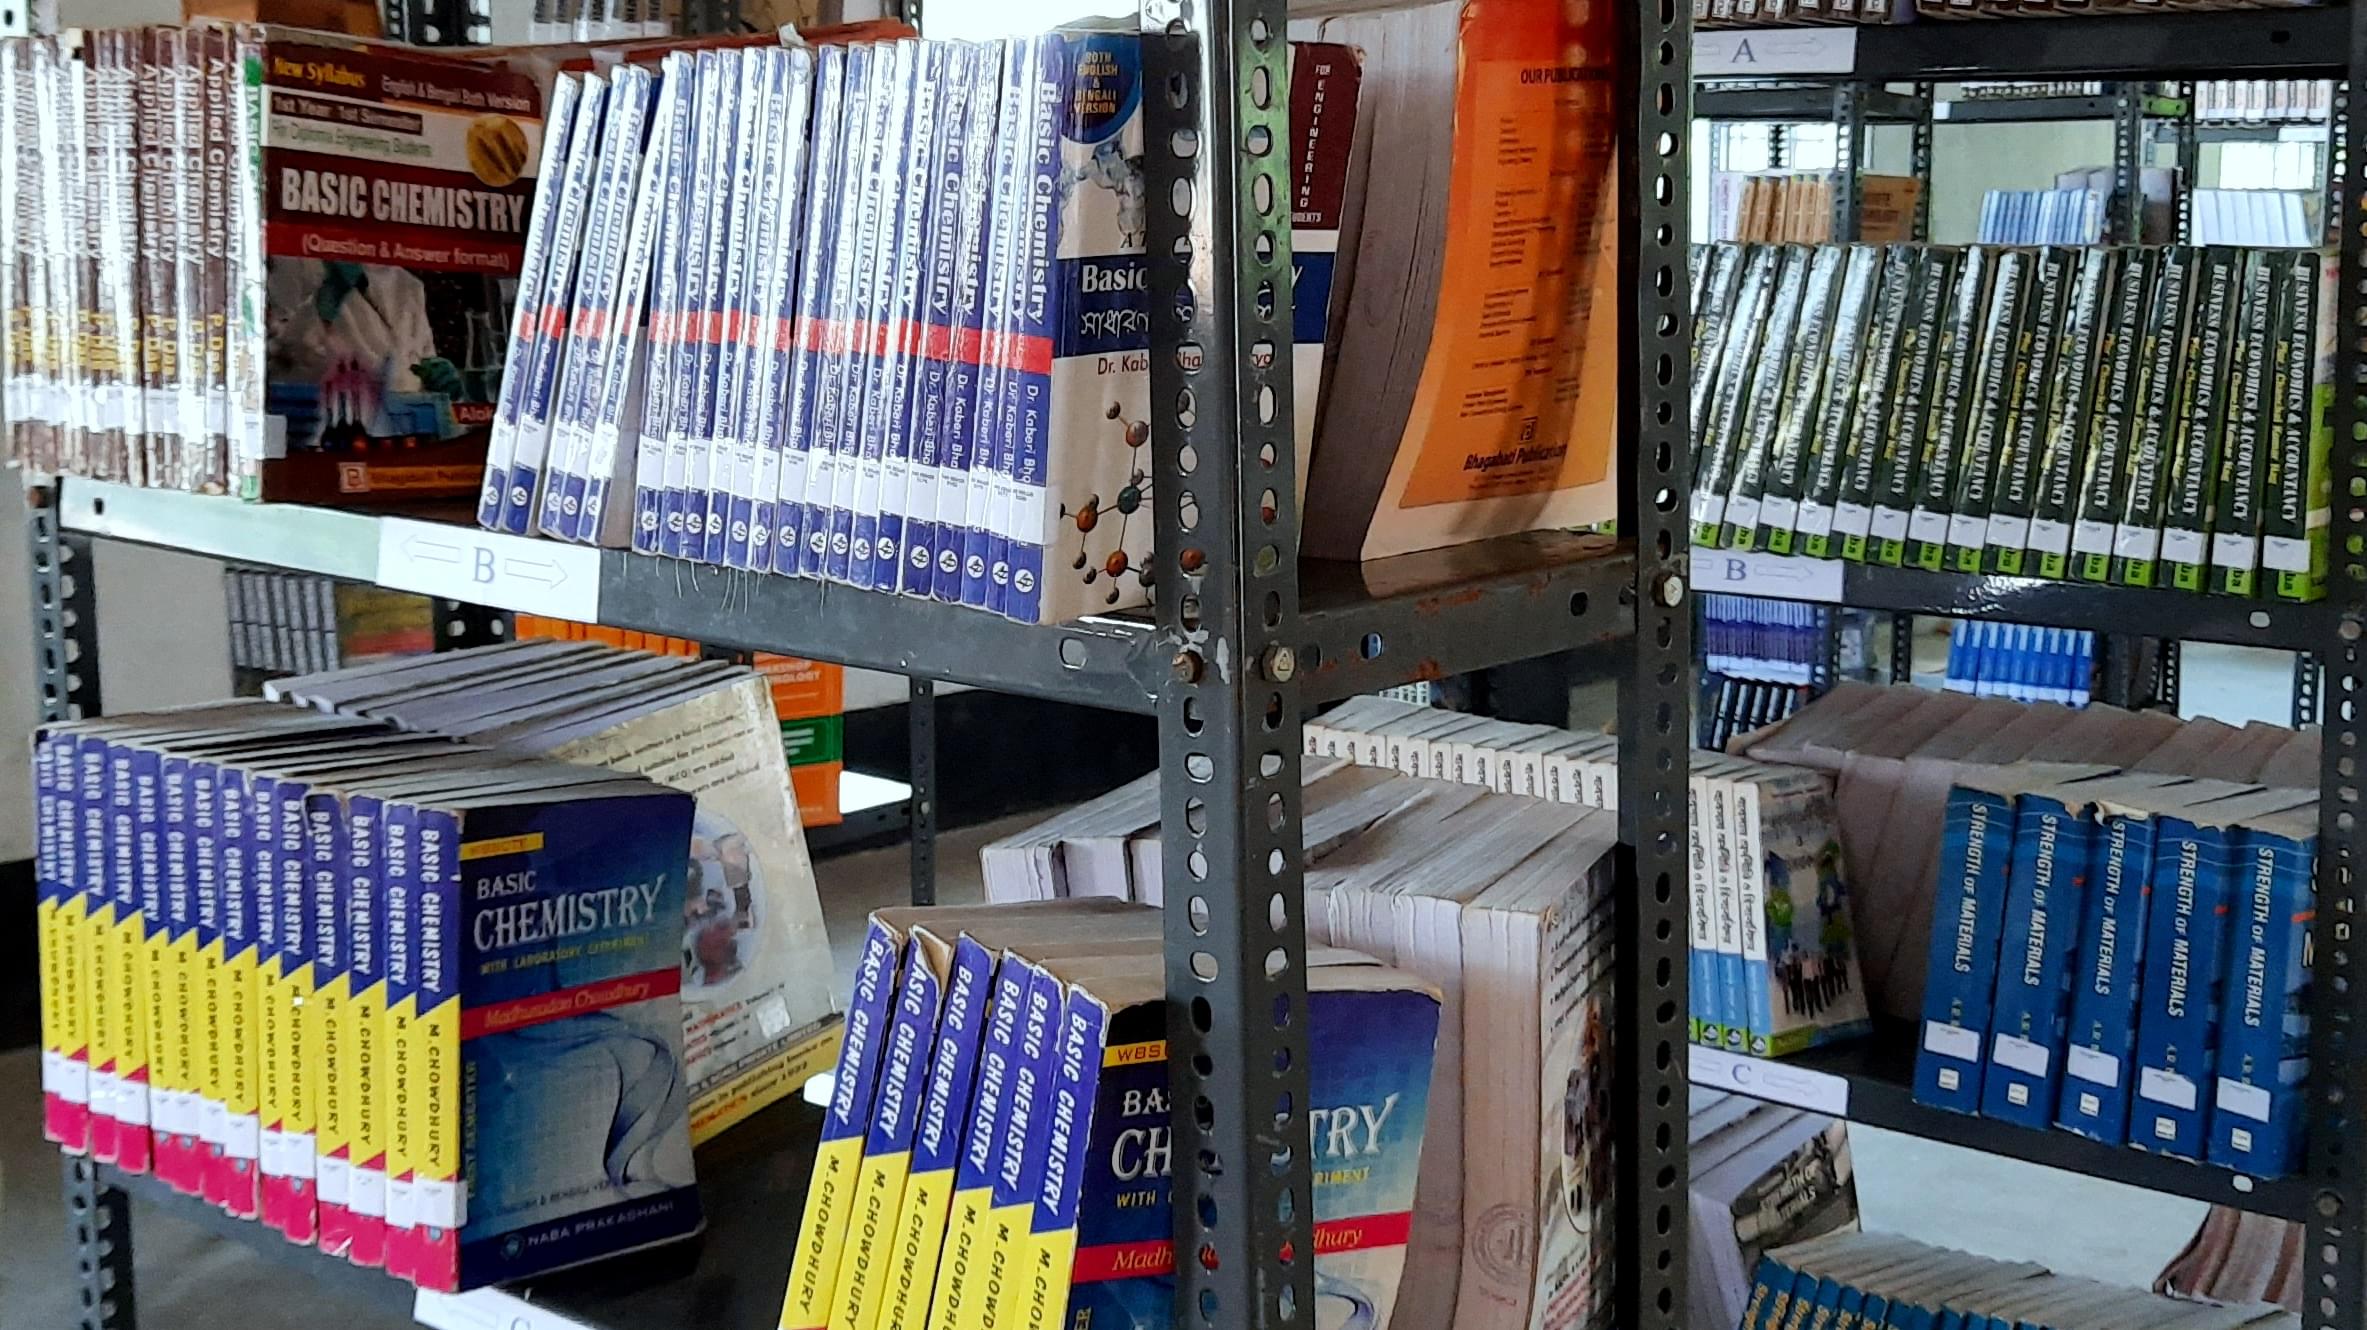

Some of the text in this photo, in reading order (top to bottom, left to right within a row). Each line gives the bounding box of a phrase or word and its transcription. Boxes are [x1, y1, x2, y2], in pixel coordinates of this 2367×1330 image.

[274, 57, 367, 88] New Syllabus
[1077, 64, 1118, 76] ENGLISH
[1315, 64, 1331, 75] FOR
[1520, 68, 1543, 84] OUR
[1731, 38, 1756, 63] A
[1074, 101, 1116, 113] VERSION
[281, 167, 526, 234] BASIC CHEMISTRY
[1026, 82, 1056, 325] Basic Chemistry
[931, 172, 960, 316] Chemistry
[1097, 353, 1149, 375] Dr. Kab
[473, 548, 496, 584] B
[1725, 558, 1747, 581] B
[195, 779, 217, 928] BASIC CHEMISTRY
[223, 789, 244, 940] BASIC CHEMISTRY
[255, 791, 274, 944] BASIC CHEMISTRY
[282, 799, 302, 956] BASIC CHEMISTRY
[1967, 803, 1988, 876] STRENGTH
[2035, 813, 2058, 887] STRENGTH
[2105, 820, 2125, 895] STRENGTH
[2177, 840, 2198, 916] STRENGTH
[310, 811, 335, 967] BASIC CHEMISTRY
[352, 815, 372, 975] BASIC CHEMISTRY
[388, 824, 407, 986] BASIC CHEMISTRY
[420, 829, 441, 993] BASIC CHEMISTRY
[474, 872, 667, 951] CHEMISTRY
[477, 870, 537, 900] BASIC
[2253, 847, 2274, 924] STRENGTH
[1954, 895, 1977, 972] MATERIALS
[2024, 907, 2047, 986] MATERIALS
[2095, 916, 2116, 995] MATERIALS
[2168, 938, 2189, 1018] MATERIALS
[2245, 945, 2266, 1027] MATERIALS
[834, 939, 884, 1126] BASIC CHEMISTRY
[878, 958, 928, 1140] ASIC CHEMISTRY
[921, 965, 974, 1158] BASIC CHEMISTRY
[1117, 1042, 1168, 1062] WBS
[969, 979, 1021, 1176] BASIC CHEMISTRY
[1000, 991, 1048, 1191] BASIC CHEMISTRY
[1041, 1011, 1087, 1217] BASIC CHEMISTRY
[1732, 1064, 1752, 1085] C
[528, 1224, 571, 1247] NABA
[800, 1155, 840, 1315] M.CHOWDHURY
[1116, 1190, 1157, 1209] WITH
[888, 1187, 928, 1330] M.CHOWDHUR
[944, 1204, 976, 1330] M.CHOWDH
